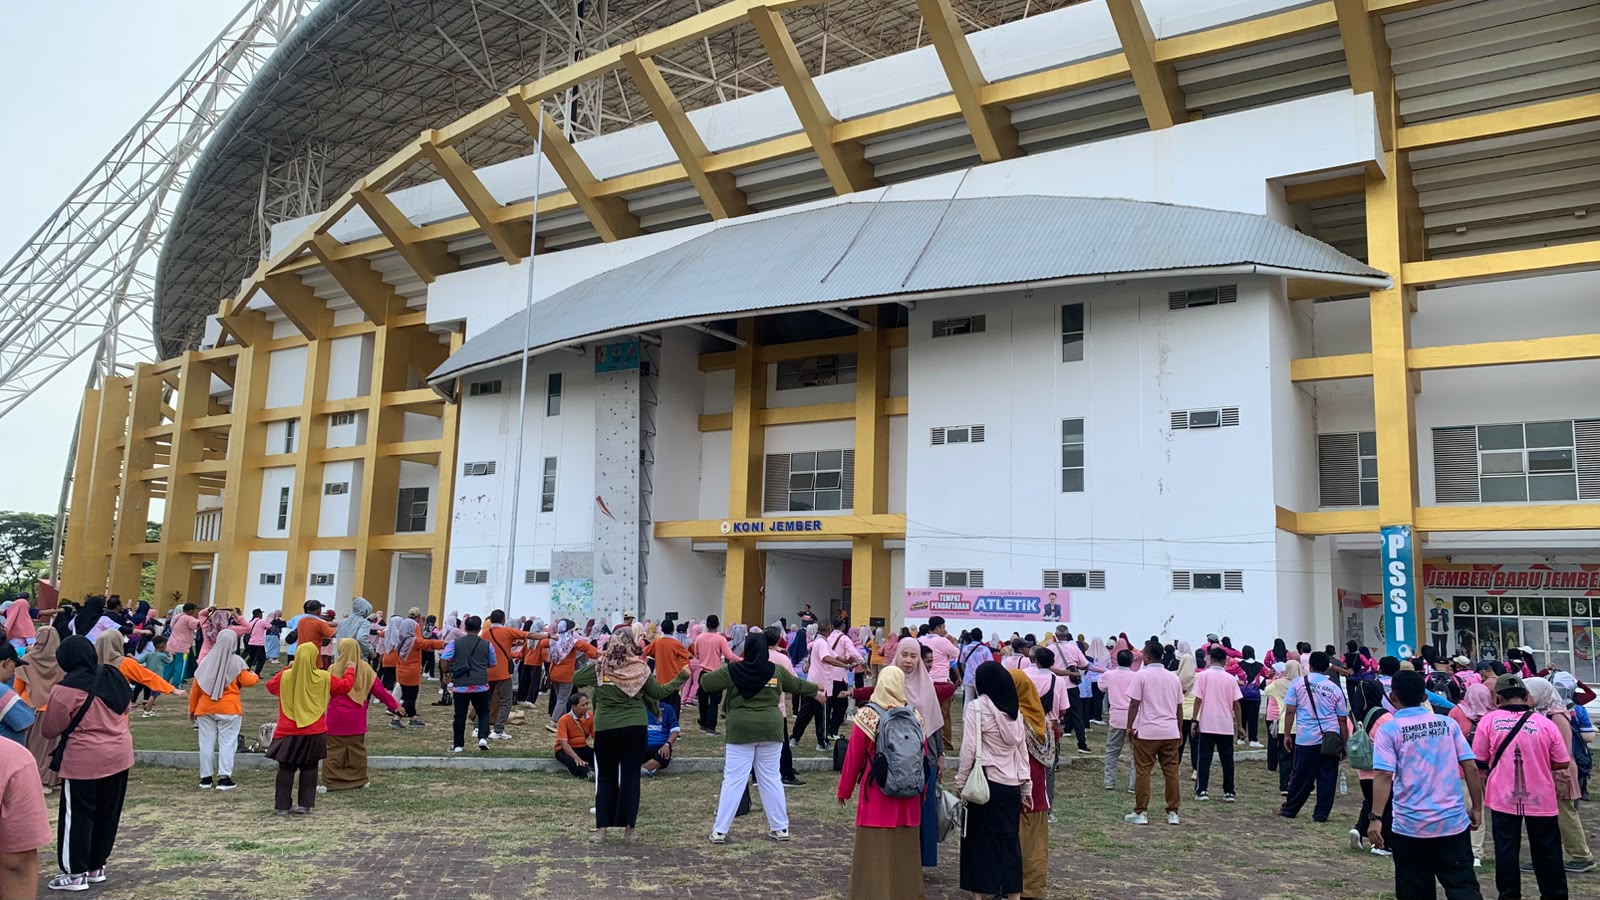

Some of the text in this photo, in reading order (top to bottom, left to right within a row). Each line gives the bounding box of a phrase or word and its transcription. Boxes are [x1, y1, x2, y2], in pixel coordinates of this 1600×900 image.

[733, 520, 822, 533] KONI JEMBER
[1428, 571, 1492, 588] JEMBER
[1493, 571, 1543, 589] BARU
[1388, 534, 1408, 642] PSSI
[940, 593, 961, 602] TEMPAT
[931, 601, 970, 610] PENDAFTARAN
[1401, 720, 1447, 733] JEMBER BARU
